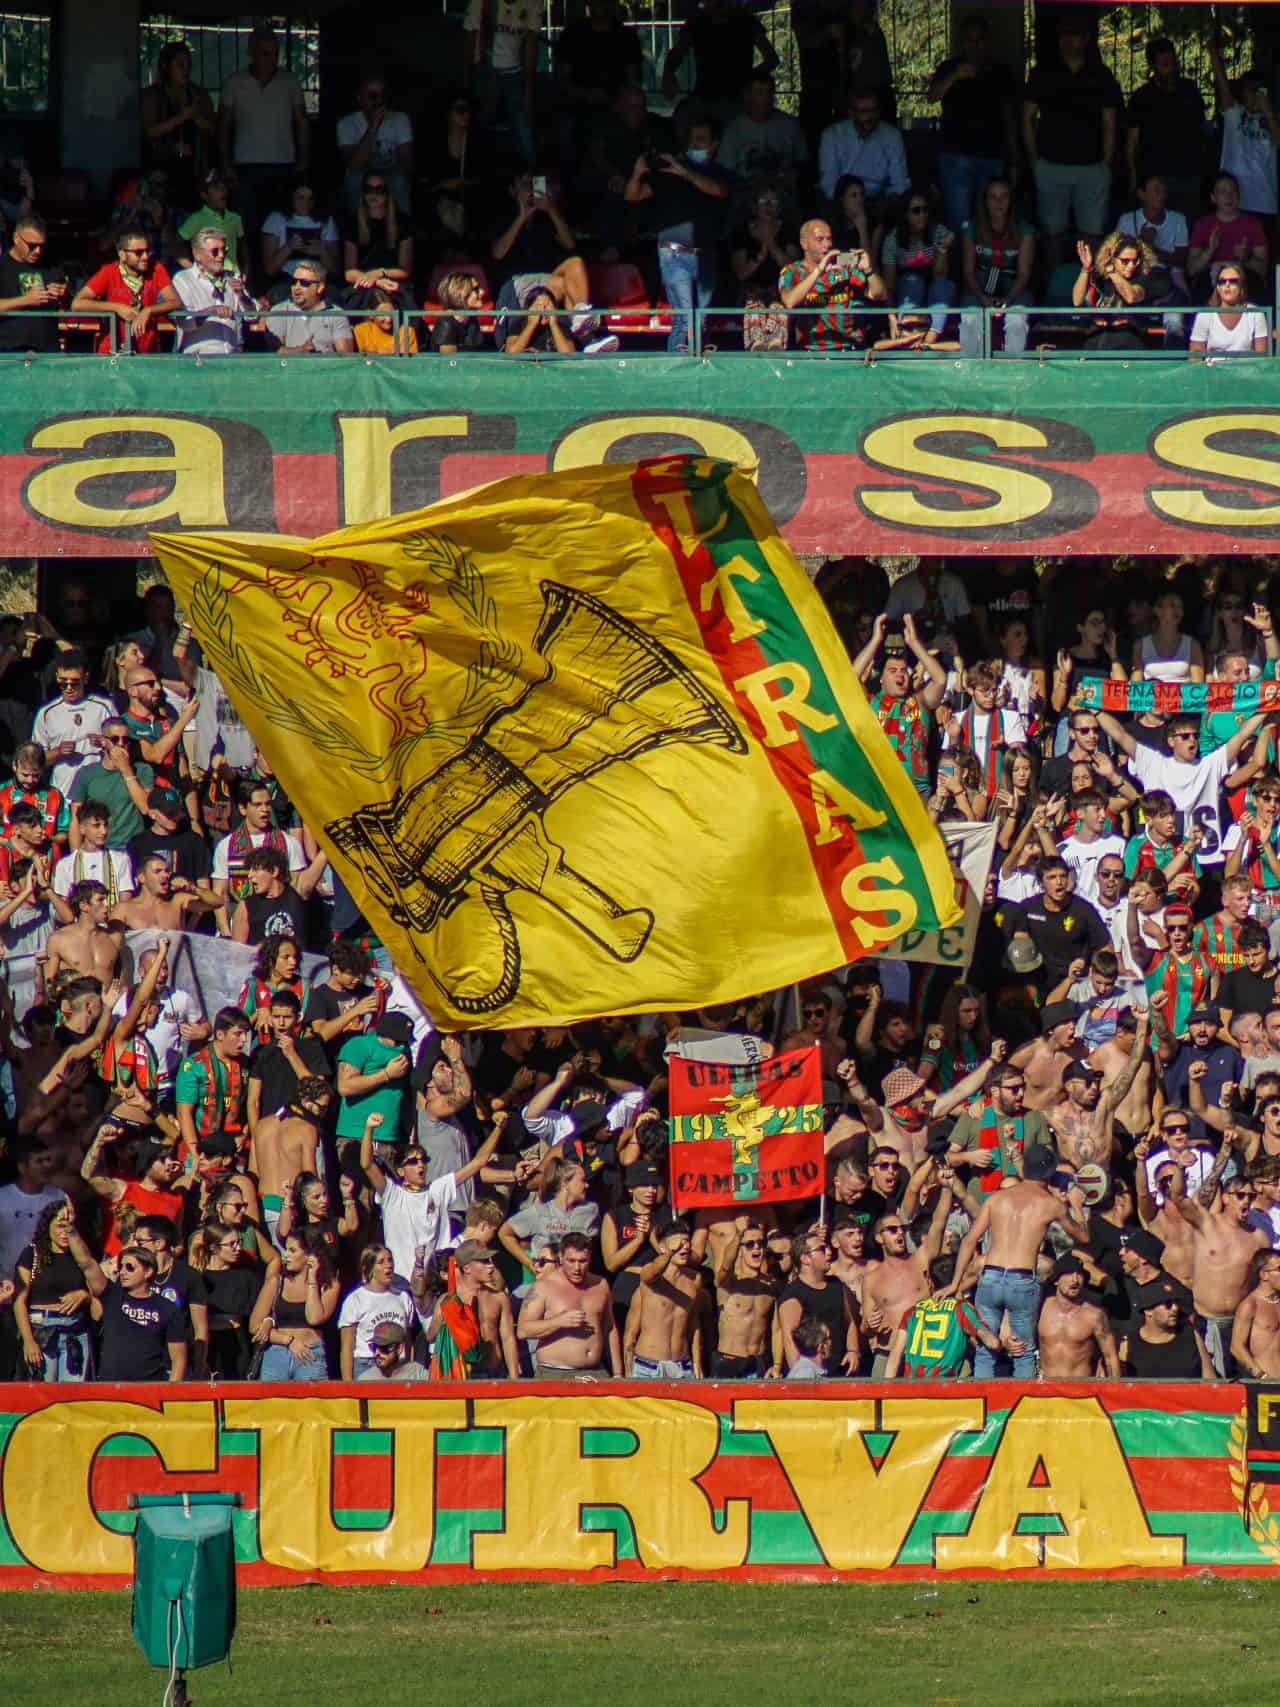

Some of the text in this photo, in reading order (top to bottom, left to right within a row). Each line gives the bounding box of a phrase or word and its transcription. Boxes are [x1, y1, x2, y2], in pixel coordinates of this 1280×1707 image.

[1105, 682, 1257, 701] TERNANA CALCIO
[909, 1309, 950, 1358] 12
[2, 1396, 1187, 1574] CURVA
